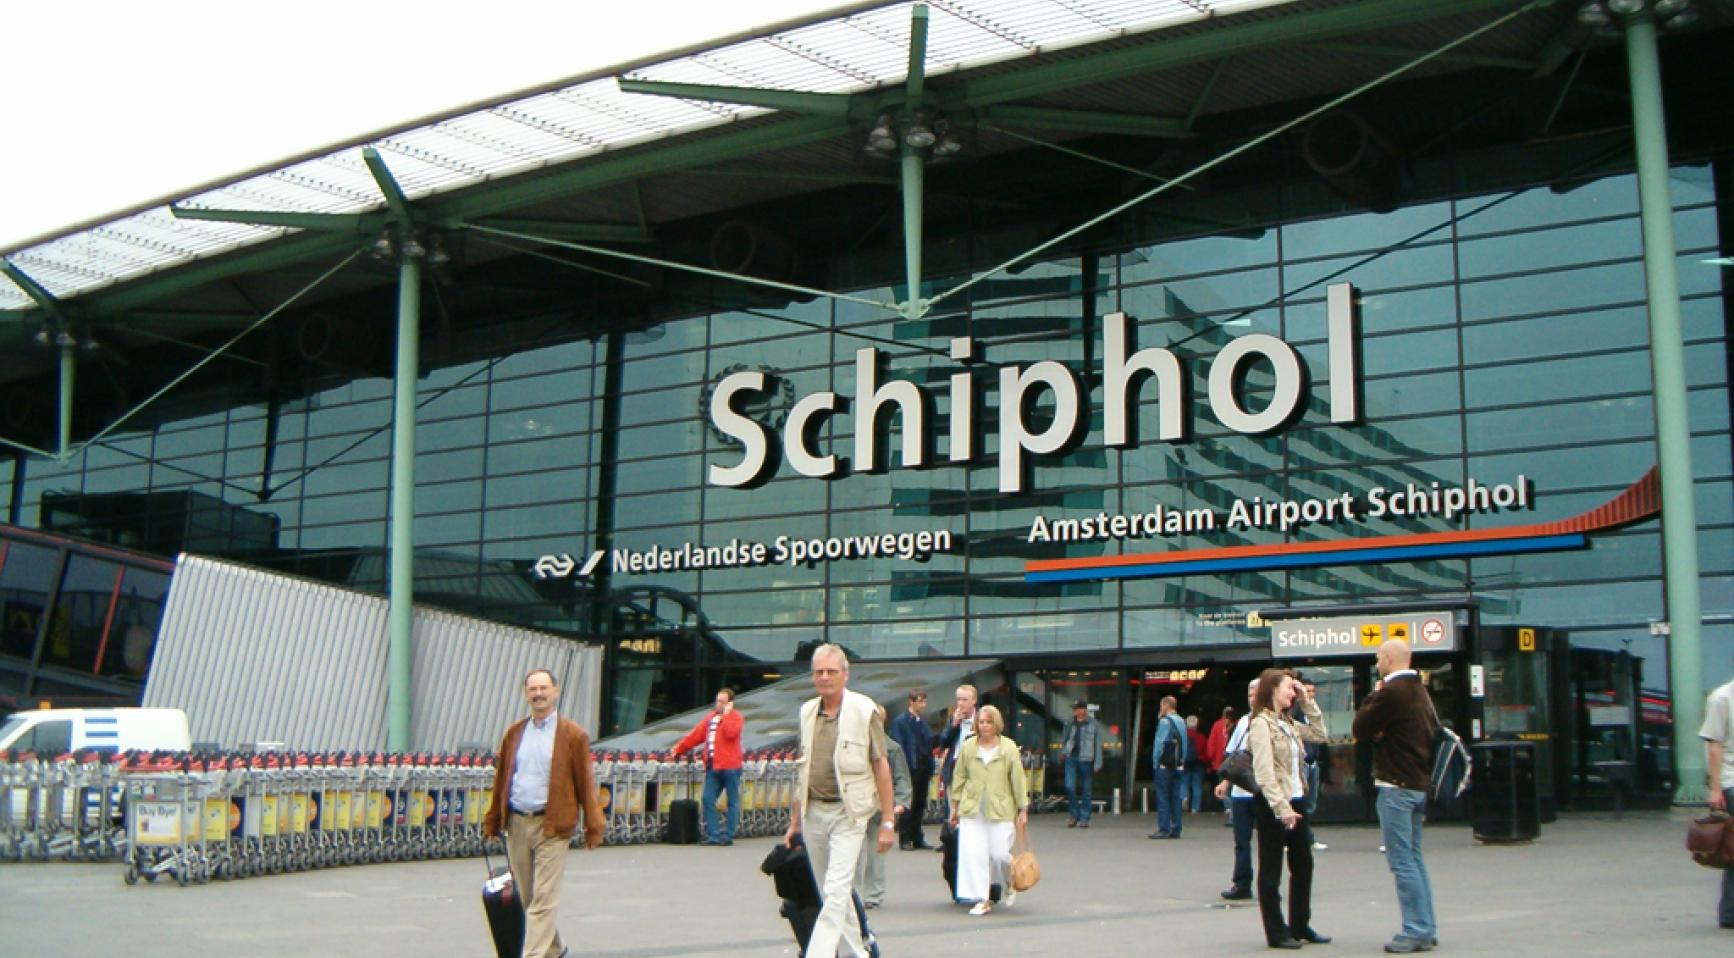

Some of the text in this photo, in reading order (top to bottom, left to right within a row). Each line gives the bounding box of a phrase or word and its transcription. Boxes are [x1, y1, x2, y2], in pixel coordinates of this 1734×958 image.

[708, 281, 1358, 493] Schiphol
[1027, 474, 1527, 543] Amsterdam Airport Schiphol
[612, 528, 951, 573] Nederlandse Spoorwegen
[1278, 626, 1358, 649] Schiphol
[1522, 630, 1533, 648] D
